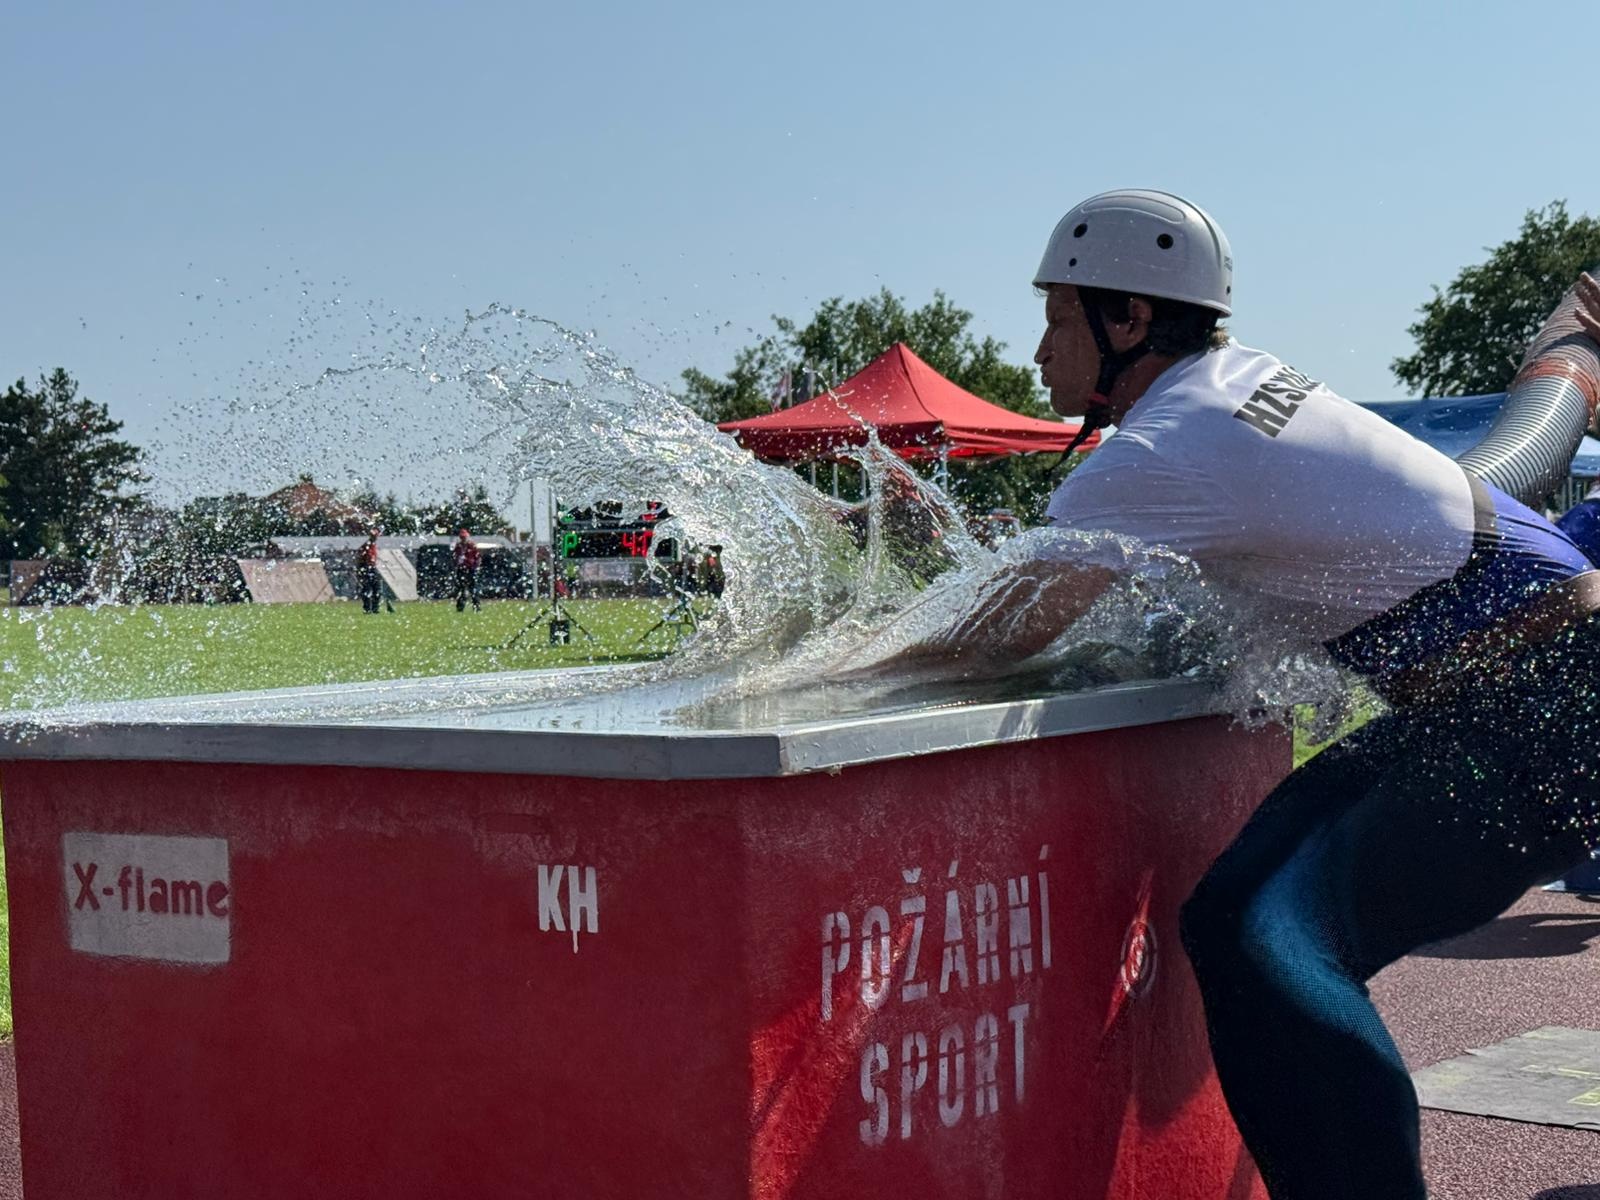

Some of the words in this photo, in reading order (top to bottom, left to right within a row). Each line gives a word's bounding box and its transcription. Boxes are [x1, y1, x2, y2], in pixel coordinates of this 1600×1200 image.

[72, 862, 229, 918] X-flame
[538, 865, 599, 934] KH
[820, 844, 1051, 1022] POŽÁRNÍ
[859, 1003, 1030, 1147] SPORT
